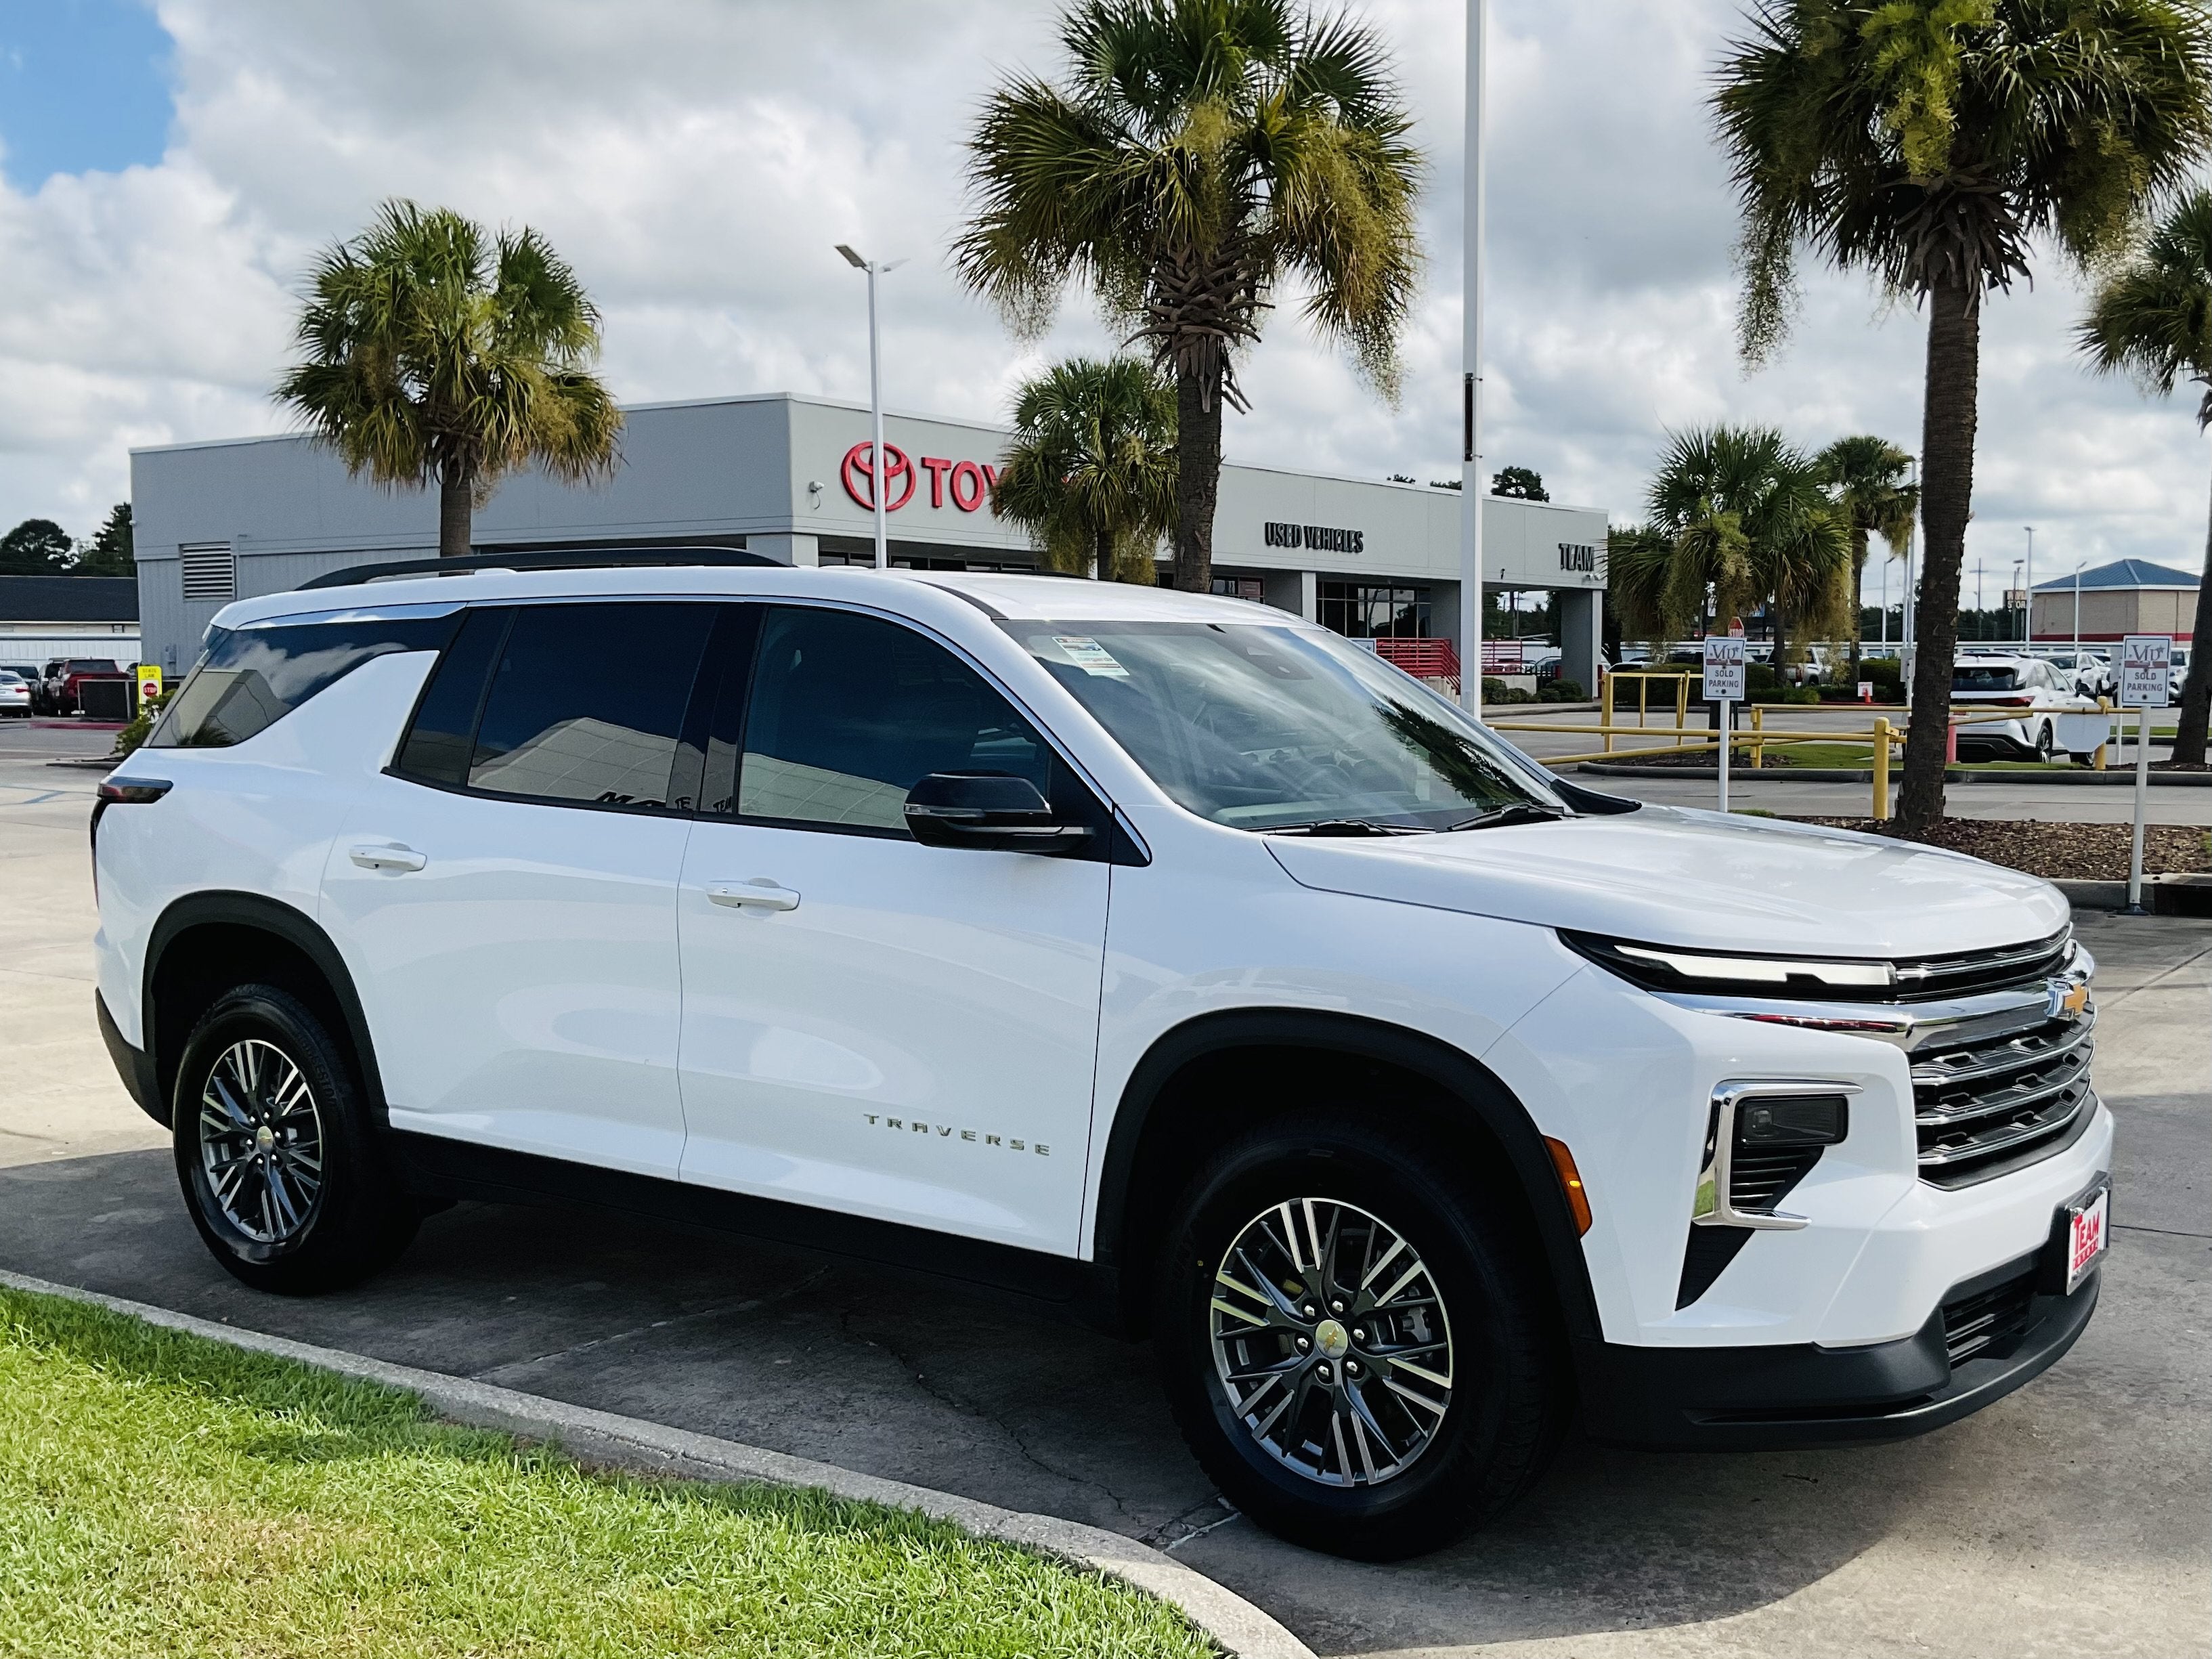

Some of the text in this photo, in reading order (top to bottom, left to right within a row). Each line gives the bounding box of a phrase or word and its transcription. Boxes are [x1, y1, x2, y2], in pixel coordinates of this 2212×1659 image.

[921, 457, 1013, 517] TOY
[1265, 522, 1364, 553] USED VEHICLES
[1559, 543, 1594, 571] TEAM
[1708, 679, 1739, 688] PARKING
[2127, 683, 2163, 691] PARKING
[2135, 672, 2156, 681] SOLD
[863, 1114, 1049, 1157] TRAVERSE
[2074, 1210, 2100, 1255] TEAM
